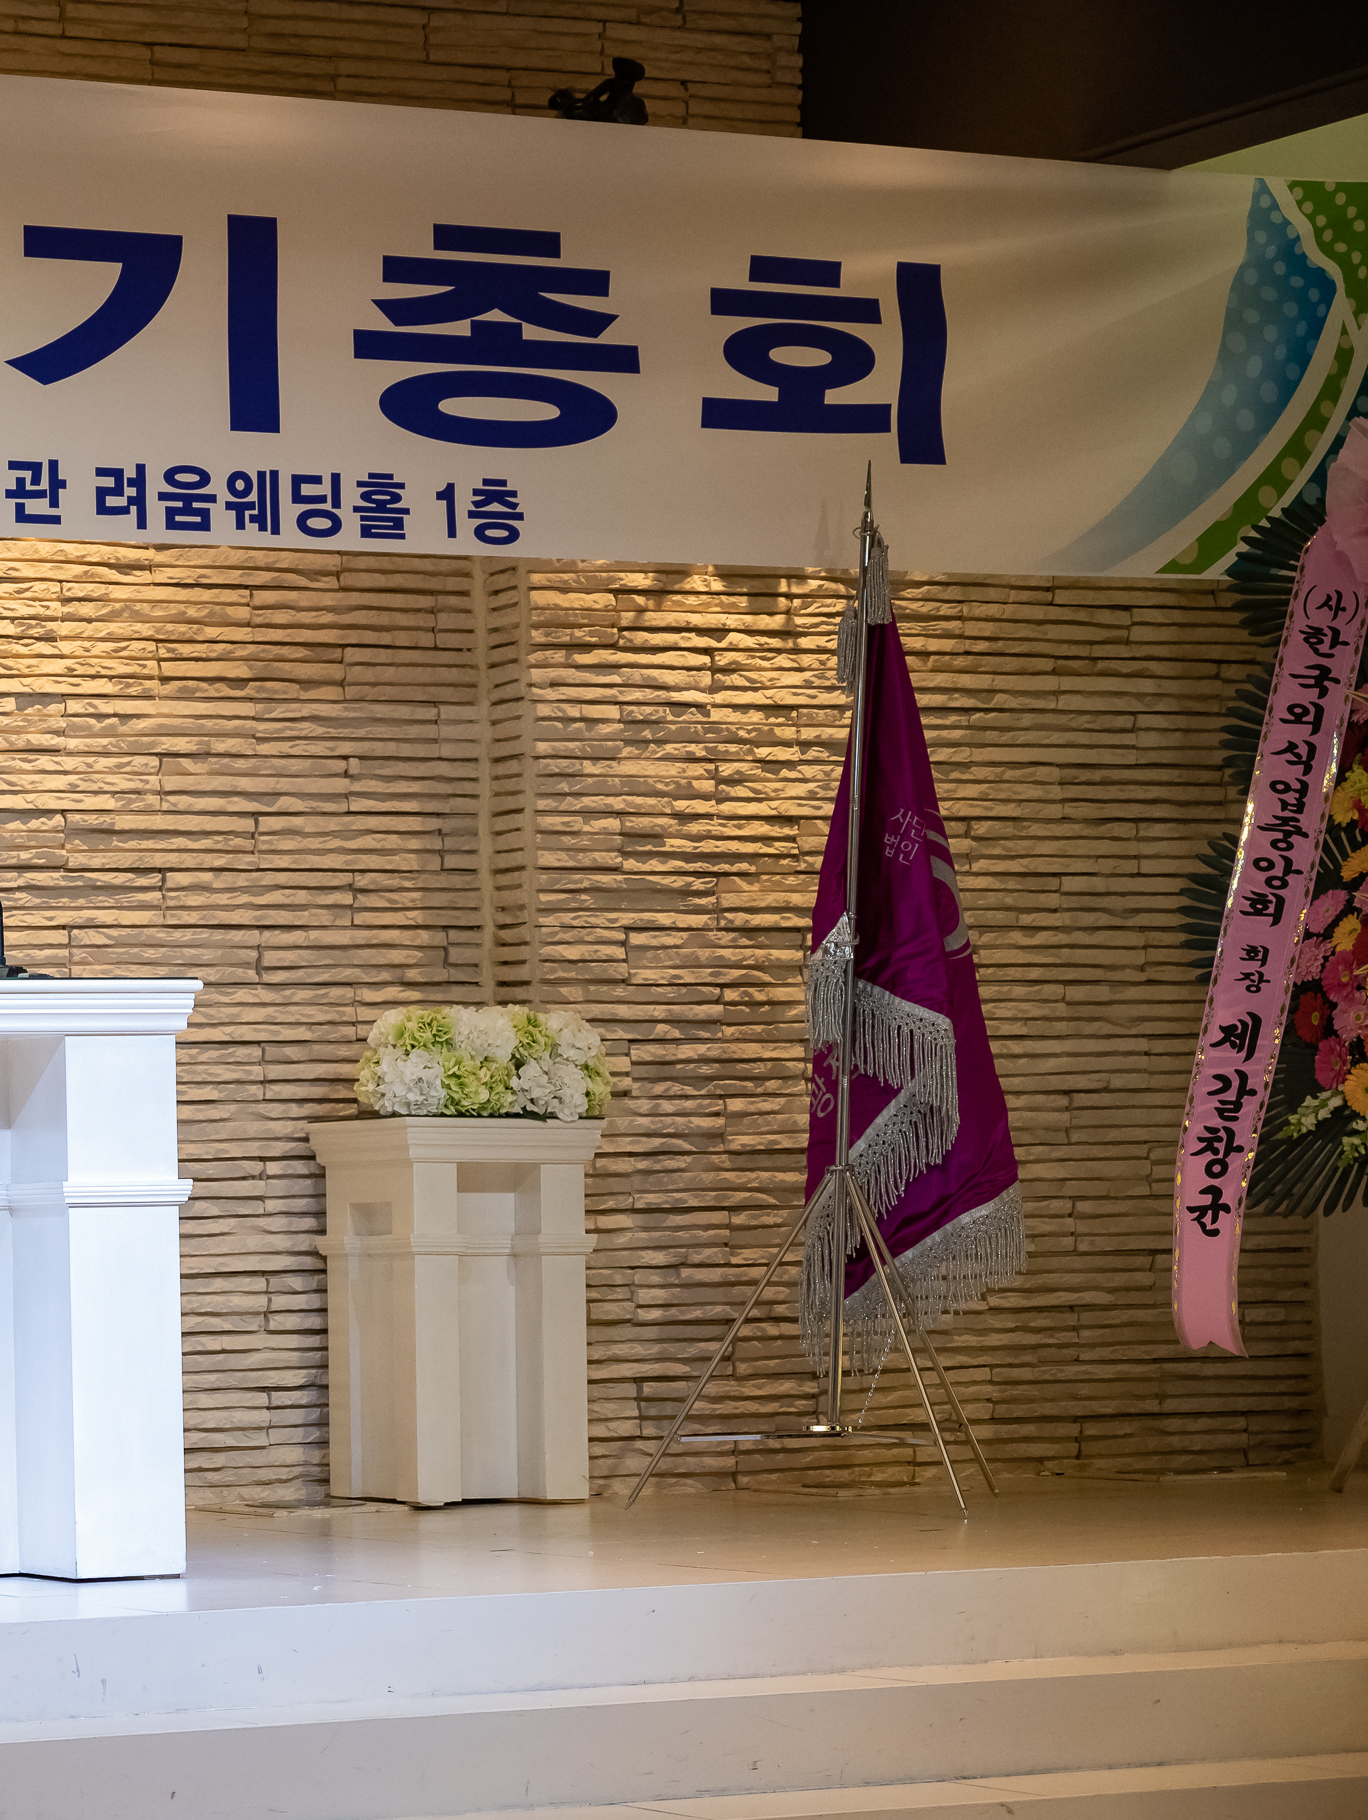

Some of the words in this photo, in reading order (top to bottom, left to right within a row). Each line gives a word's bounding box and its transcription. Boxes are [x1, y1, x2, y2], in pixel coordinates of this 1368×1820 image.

[94, 462, 411, 542] 려움웨딩홀
[435, 477, 525, 546] 1층
[1234, 944, 1271, 994] 회장
